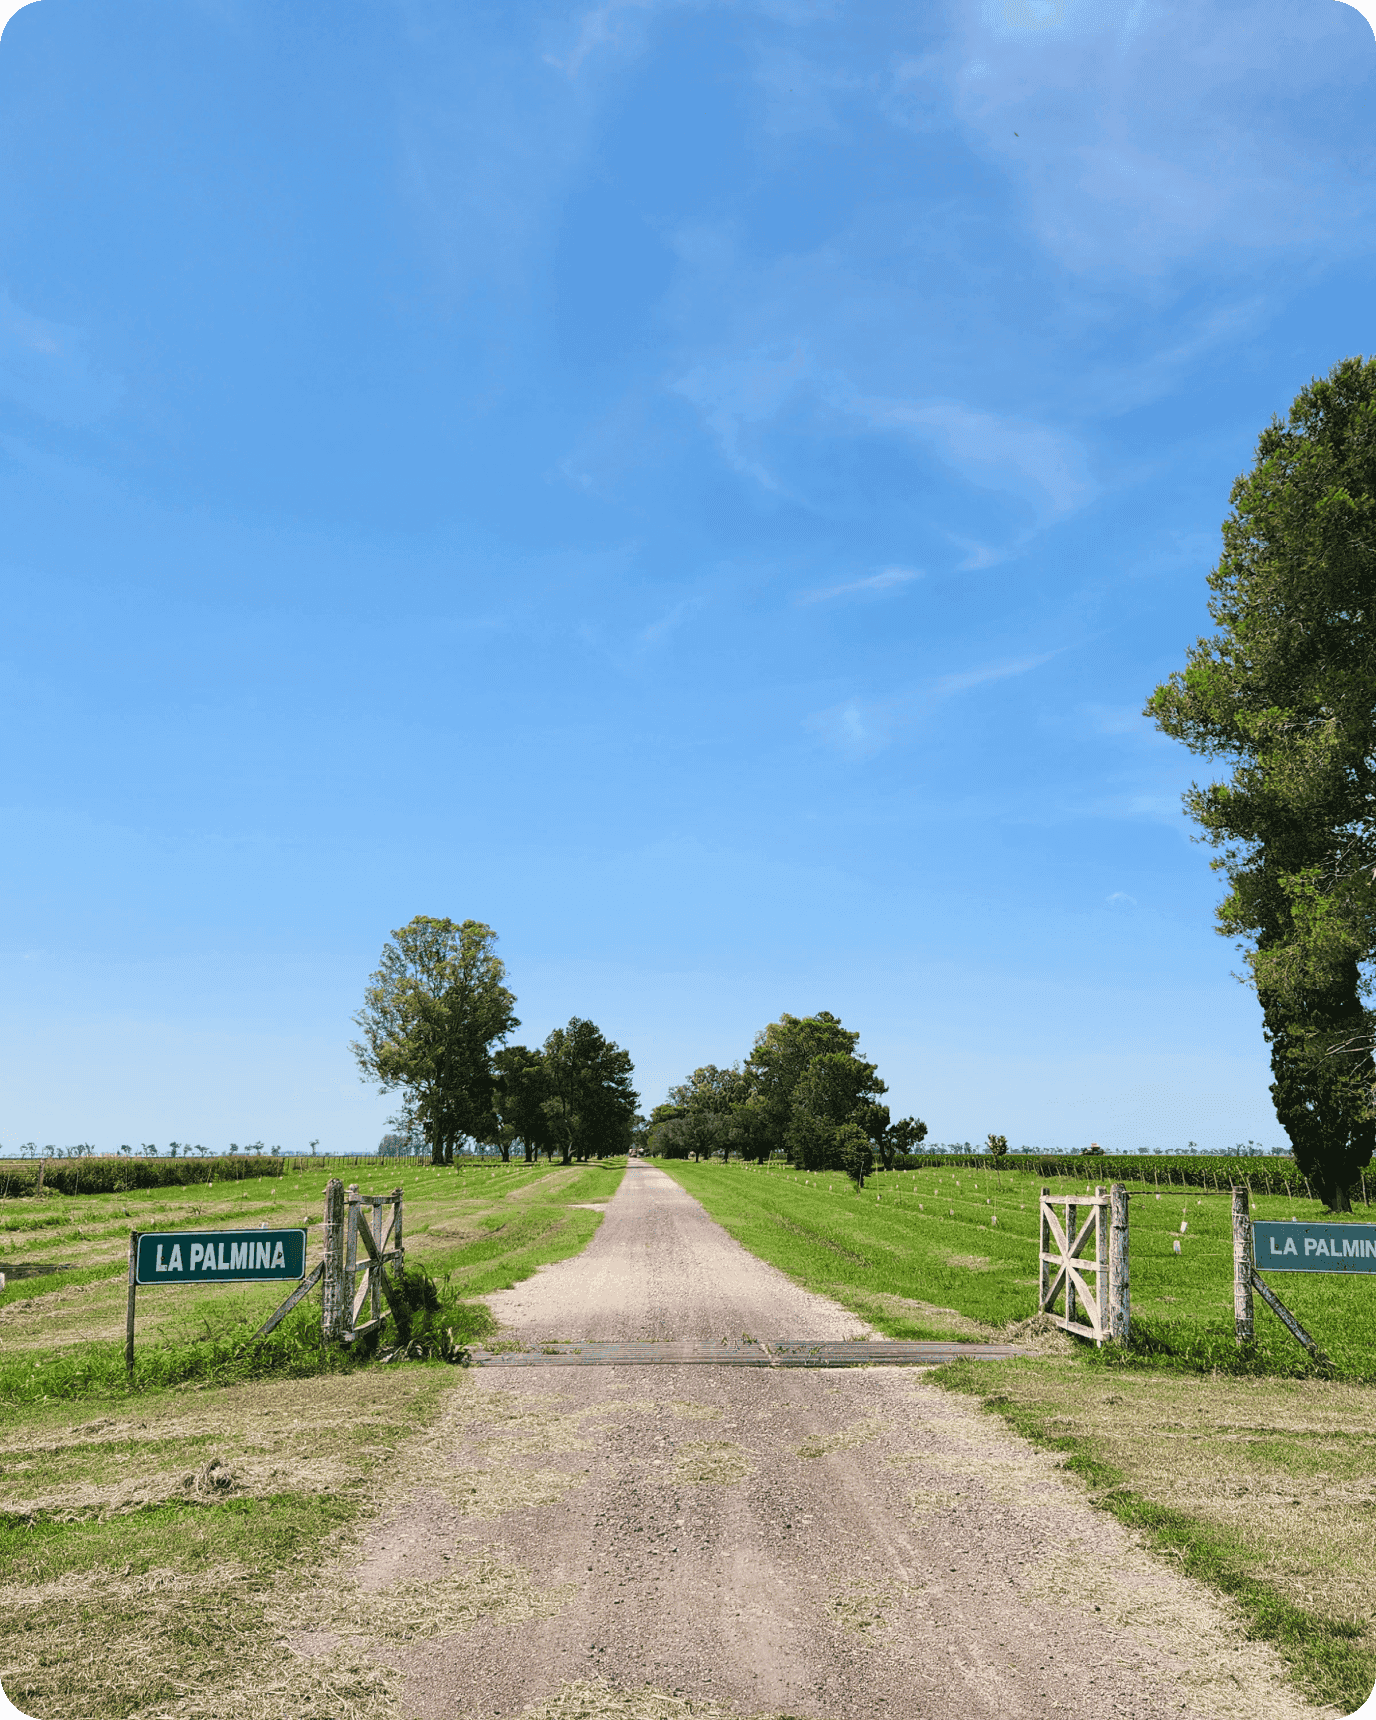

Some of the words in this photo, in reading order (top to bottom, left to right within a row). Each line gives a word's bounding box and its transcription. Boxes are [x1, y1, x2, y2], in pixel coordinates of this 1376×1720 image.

[155, 1243, 184, 1272] LA
[189, 1241, 286, 1271] PALMINA
[1269, 1236, 1299, 1256] LA
